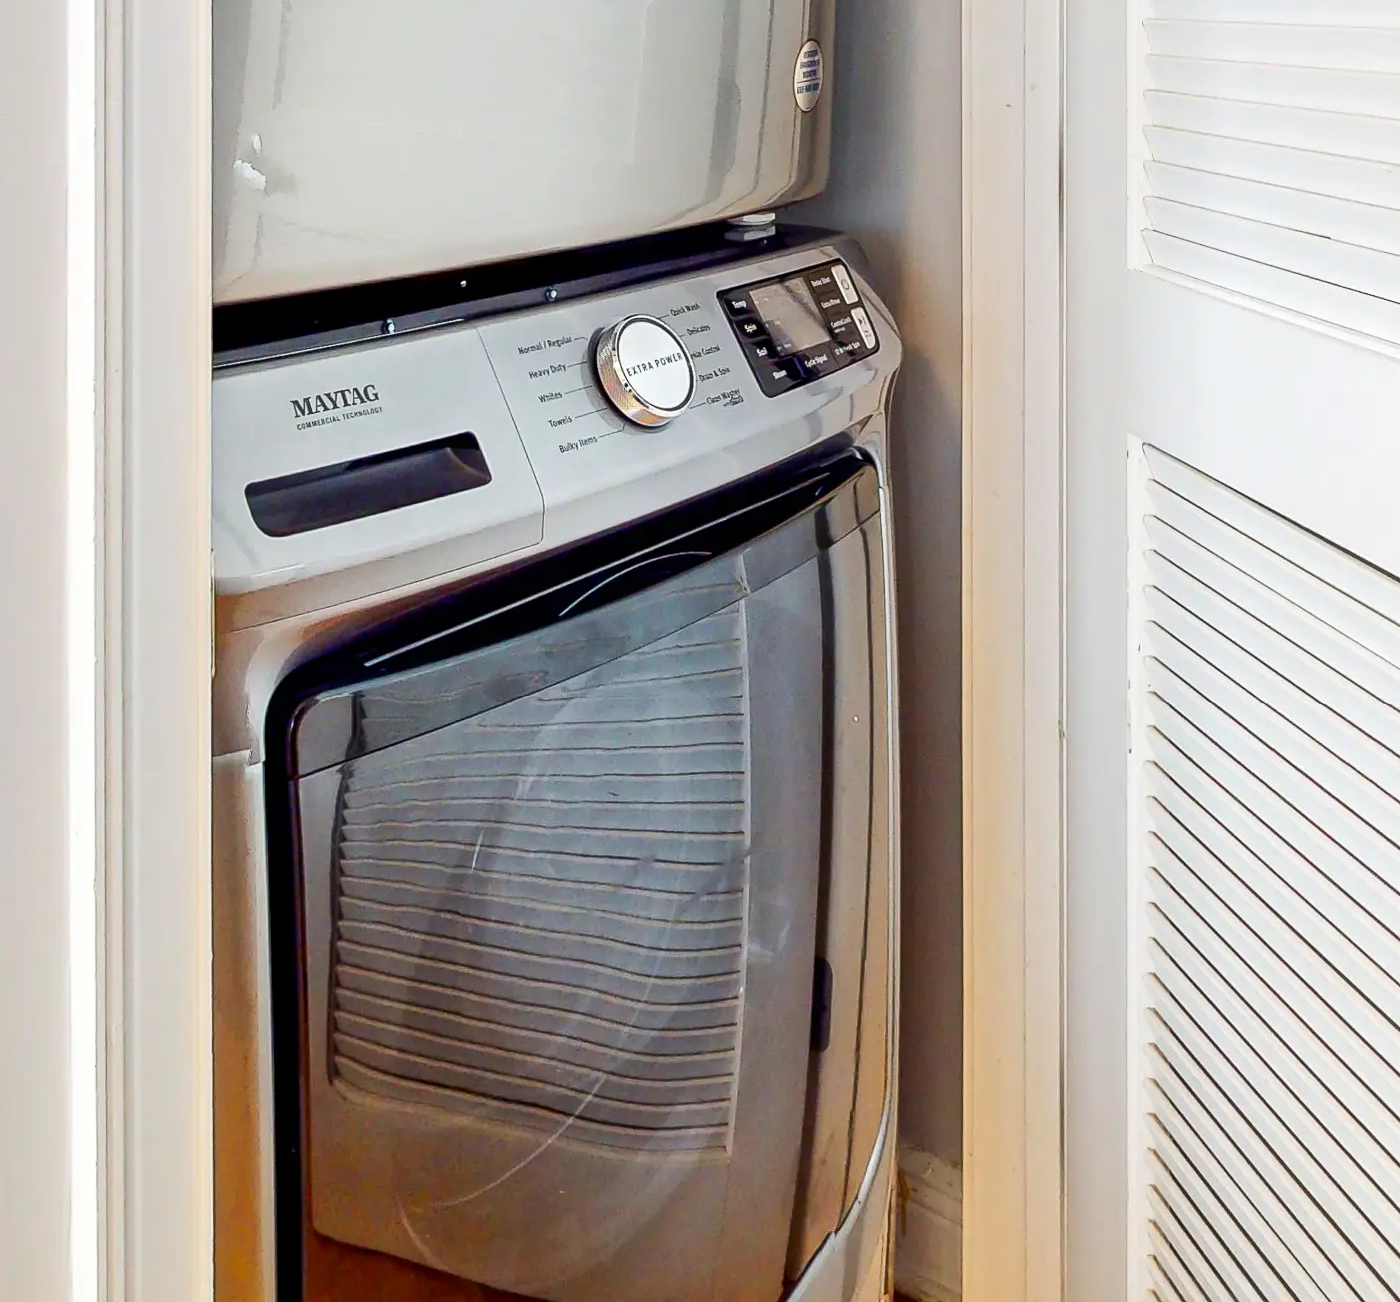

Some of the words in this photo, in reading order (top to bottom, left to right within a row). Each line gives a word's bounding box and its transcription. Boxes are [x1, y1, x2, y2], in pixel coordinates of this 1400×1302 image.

[732, 300, 747, 310] Temp
[517, 341, 543, 354] Normal
[548, 336, 572, 348] Regular
[528, 367, 550, 379] Heavy
[549, 363, 567, 374] Duty
[626, 361, 653, 377] EXTRA
[654, 352, 683, 368] POWER
[290, 384, 380, 418] MAYTAG
[537, 391, 563, 403] Whites
[296, 415, 341, 431] COMMERCIAL
[342, 406, 383, 421] TECHNOLOGY
[548, 415, 573, 428] Towels
[558, 441, 579, 453] Bulky
[578, 435, 598, 448] Items
